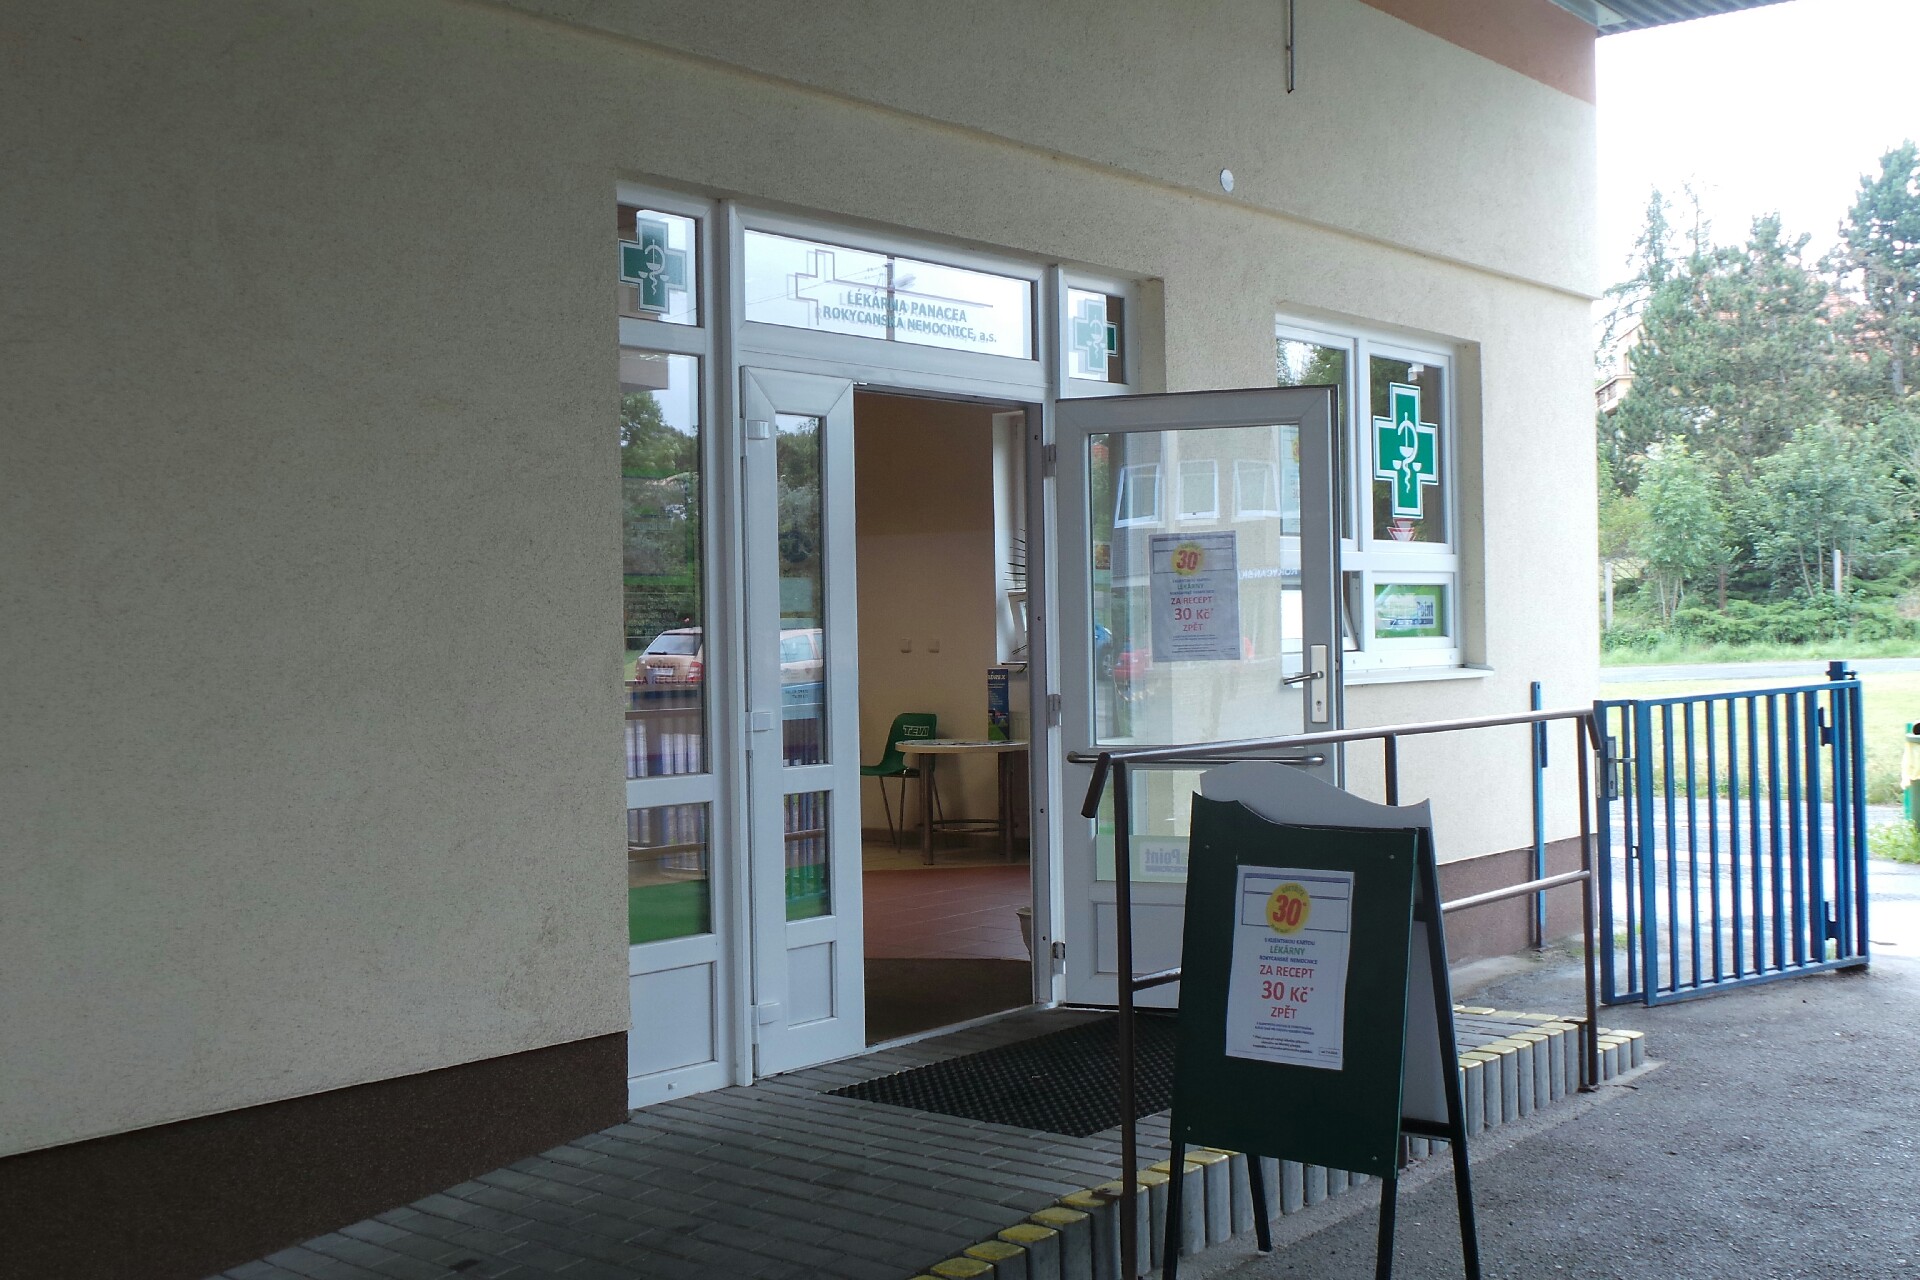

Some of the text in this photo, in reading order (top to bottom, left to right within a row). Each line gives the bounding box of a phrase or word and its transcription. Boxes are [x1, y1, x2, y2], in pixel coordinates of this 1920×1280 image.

[847, 289, 967, 322] LÉKÁRNA PANACEA
[823, 305, 904, 328] ROKYCANSKÁ
[907, 318, 977, 342] NEMOCNICE,
[1170, 596, 1213, 605] ZA RECEPT
[1174, 607, 1192, 621] 30
[1182, 622, 1204, 632] ZPĚT
[1269, 944, 1306, 956] LÉKÁRNY
[1259, 964, 1315, 979] ZA RECEPT
[1261, 980, 1285, 1001] 30
[1270, 1005, 1298, 1019] ZPĚT
